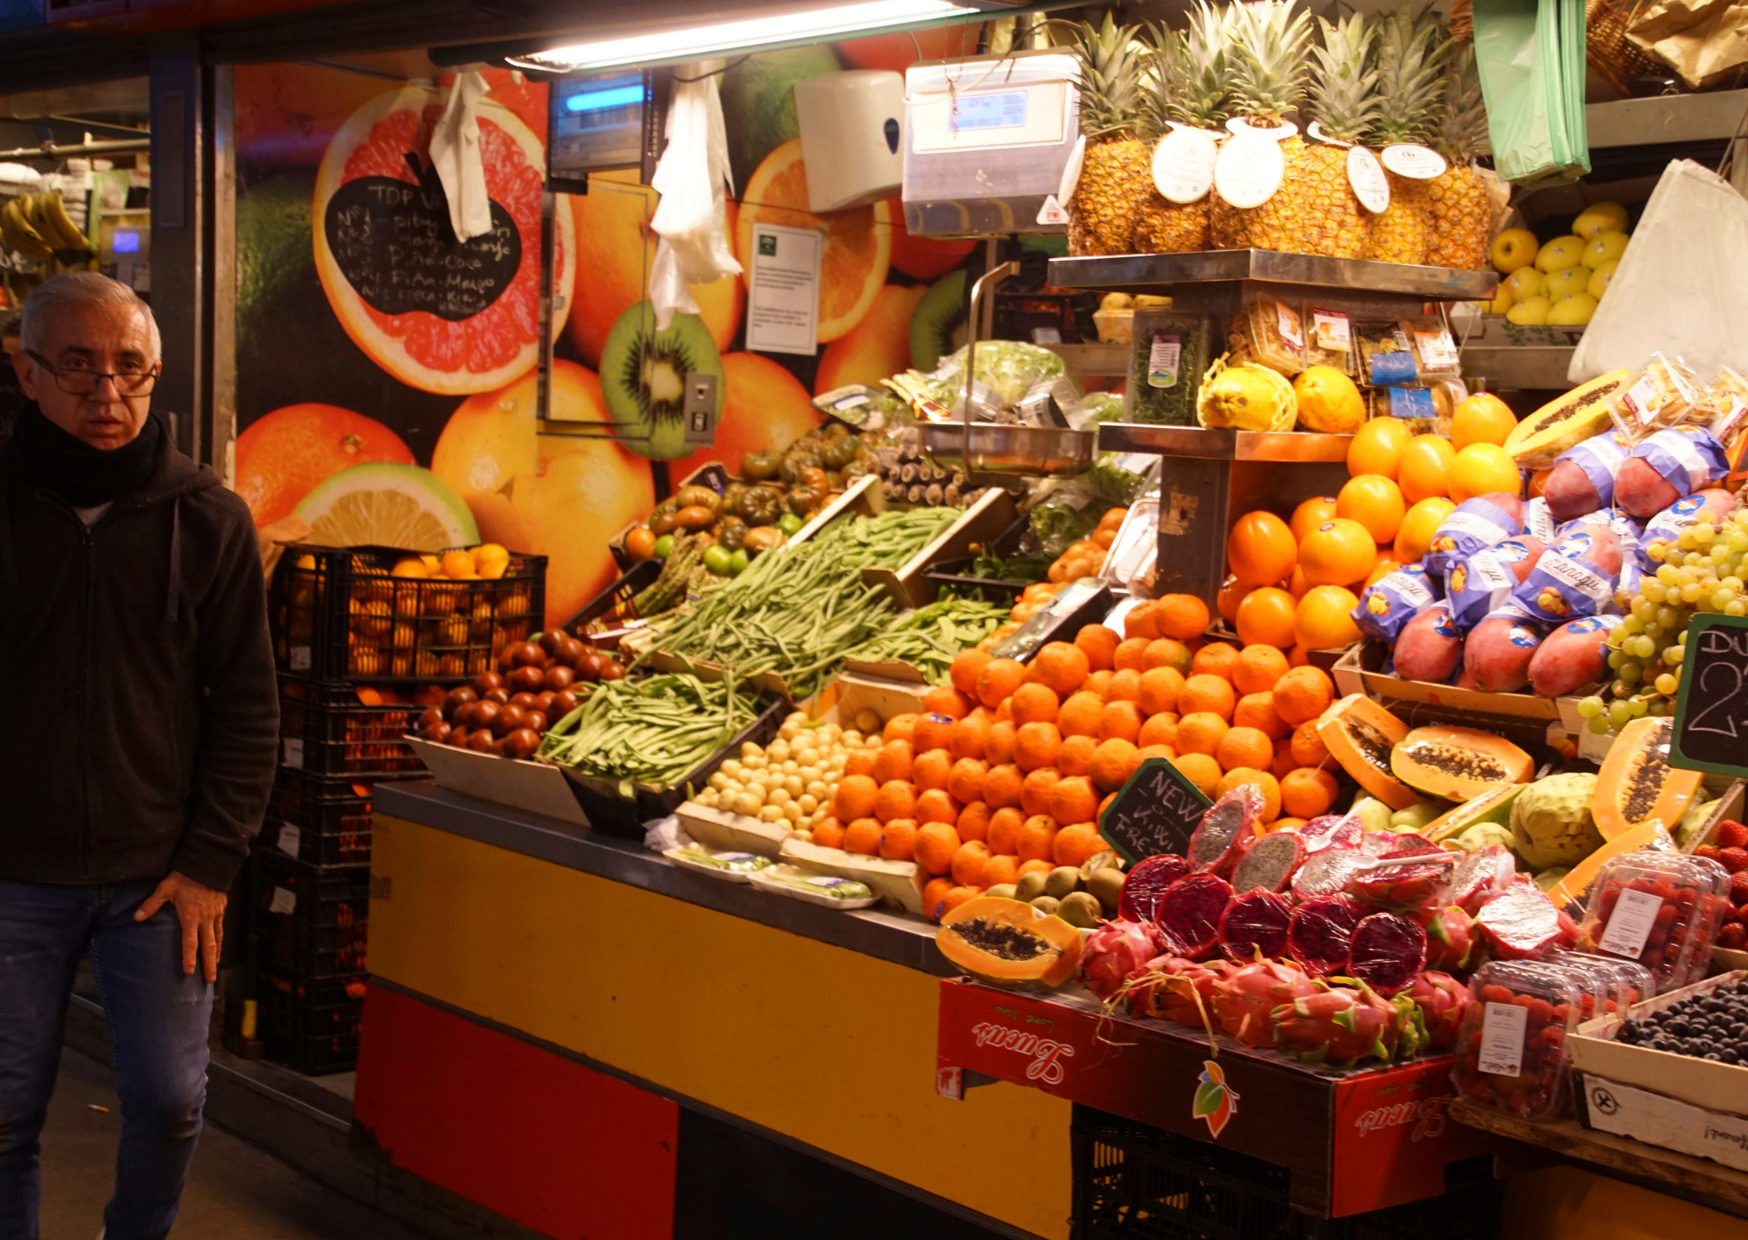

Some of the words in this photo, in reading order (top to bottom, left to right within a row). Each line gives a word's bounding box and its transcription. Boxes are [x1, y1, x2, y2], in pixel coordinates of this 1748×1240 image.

[368, 185, 413, 206] TOP
[1149, 770, 1208, 823] NEW
[971, 1021, 1076, 1086] Lucas
